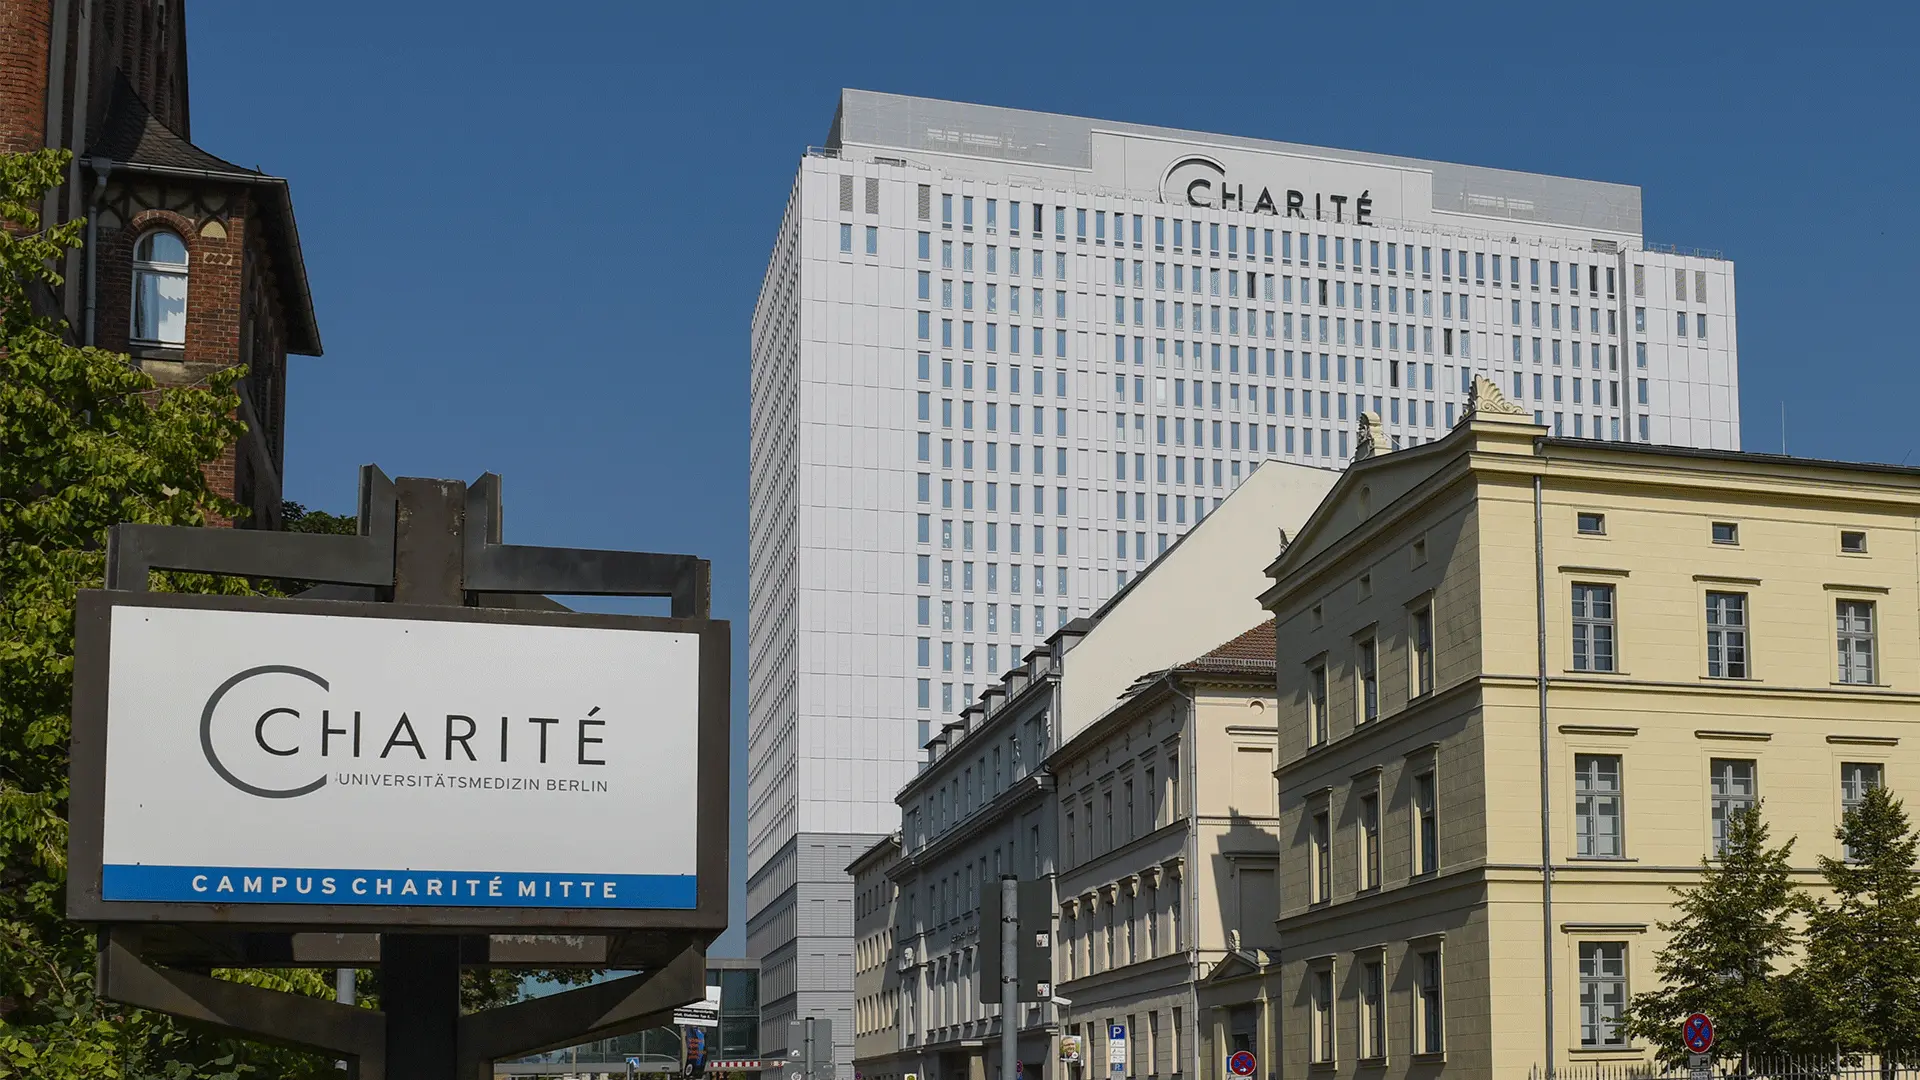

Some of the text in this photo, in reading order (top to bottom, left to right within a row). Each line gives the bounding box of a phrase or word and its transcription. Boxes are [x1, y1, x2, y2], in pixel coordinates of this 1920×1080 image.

[1187, 178, 1373, 226] CHARITÉ
[254, 705, 606, 766] CHARITÉ
[338, 772, 608, 793] UNIVERSITÄTSMEDIZIN BERLIN
[191, 874, 617, 899] CAMPUS CHARITÉ MITTE
[1113, 1027, 1122, 1038] P
